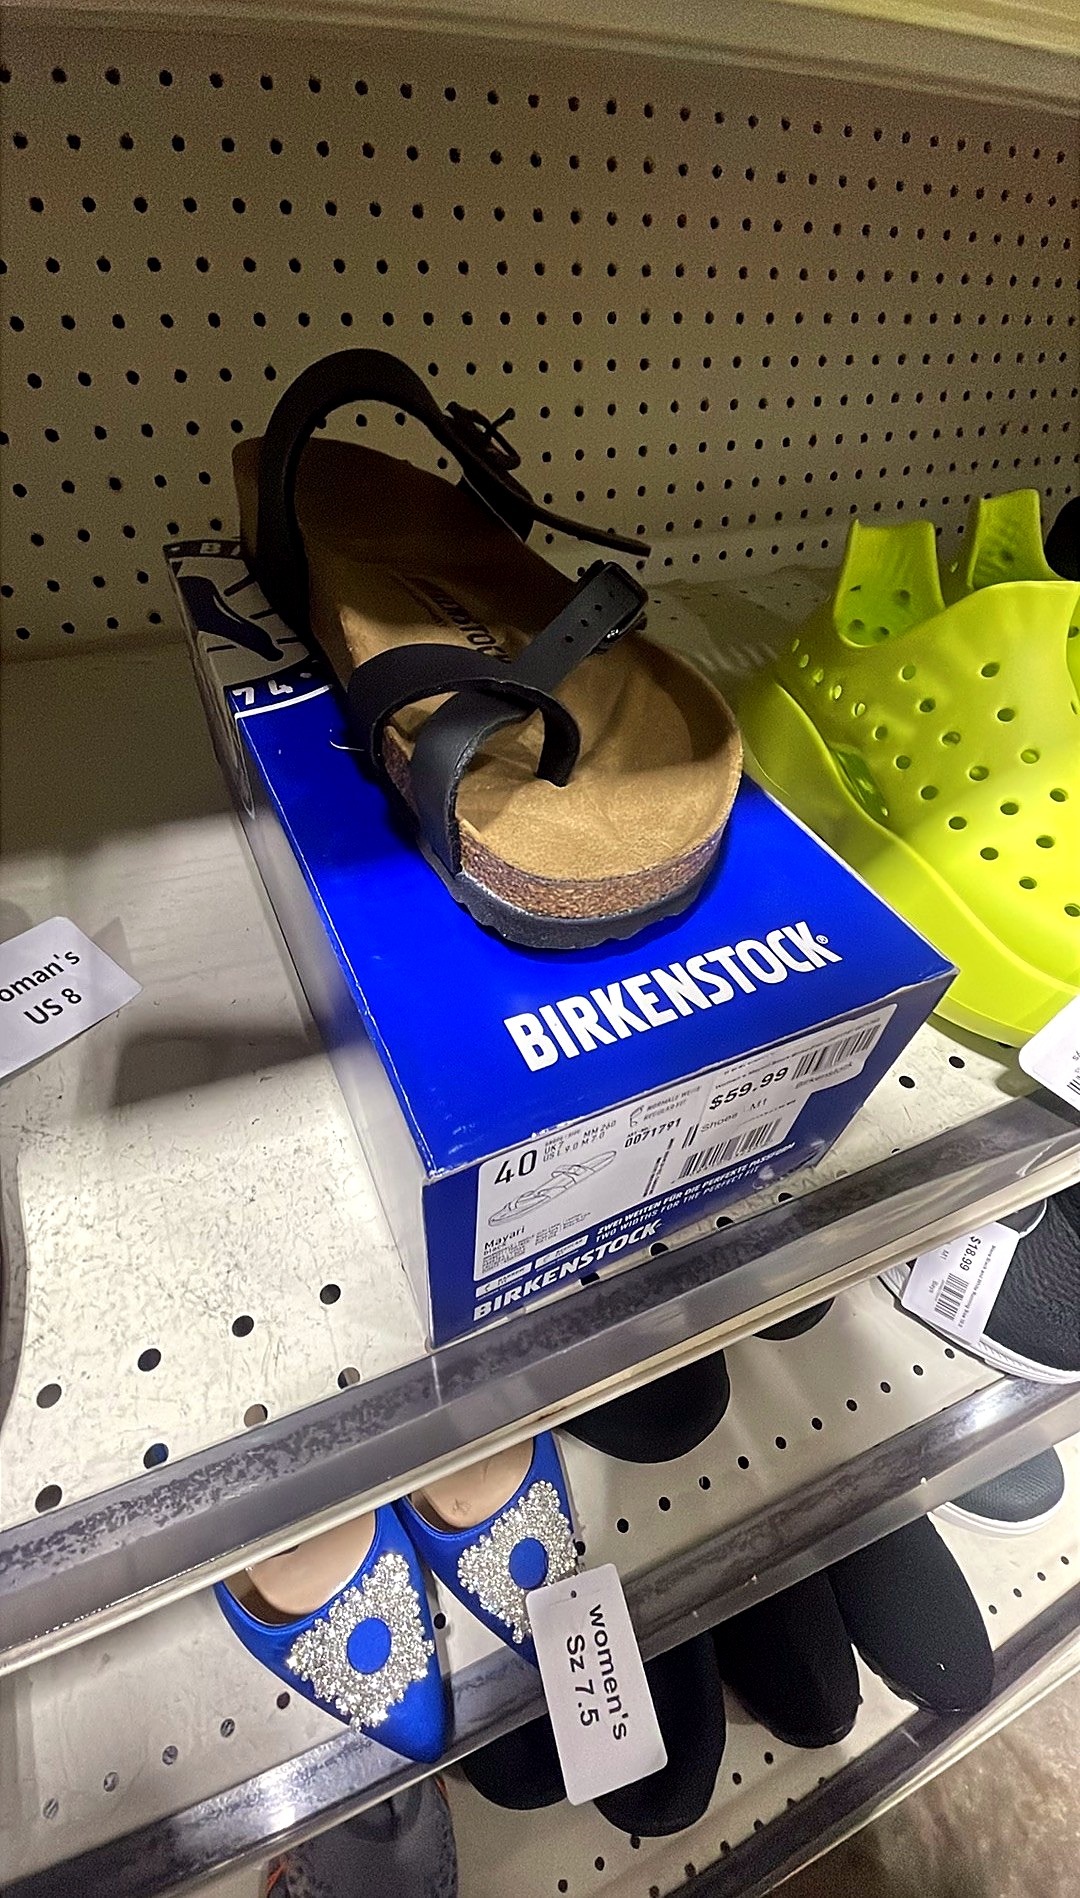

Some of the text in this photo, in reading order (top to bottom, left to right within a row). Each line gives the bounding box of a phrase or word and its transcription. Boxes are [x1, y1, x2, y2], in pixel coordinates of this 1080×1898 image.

[0, 951, 80, 1002] oman's
[503, 921, 843, 1072] BIRKENSTOCK
[23, 987, 82, 1025] US 8
[709, 1066, 789, 1110] $59.99
[624, 1117, 682, 1148] 0071791
[700, 1113, 738, 1133] Shoes
[494, 1150, 538, 1185] 40
[595, 1228, 617, 1243] TWO
[620, 1209, 659, 1231] WIDTHS
[660, 1200, 680, 1213] FOR
[683, 1191, 701, 1204] THE
[597, 1217, 623, 1235] ZWEI
[624, 1200, 662, 1222] WEITEN
[662, 1191, 684, 1205] FÜR
[684, 1183, 702, 1196] DIE
[701, 1164, 749, 1188] PERFEKTE
[484, 1225, 525, 1250] Mayari
[959, 1236, 982, 1272] $18.99
[473, 1219, 662, 1321] BIRKENSTOCK
[566, 1634, 599, 1726] Sz 7.5
[589, 1603, 628, 1740] women's
